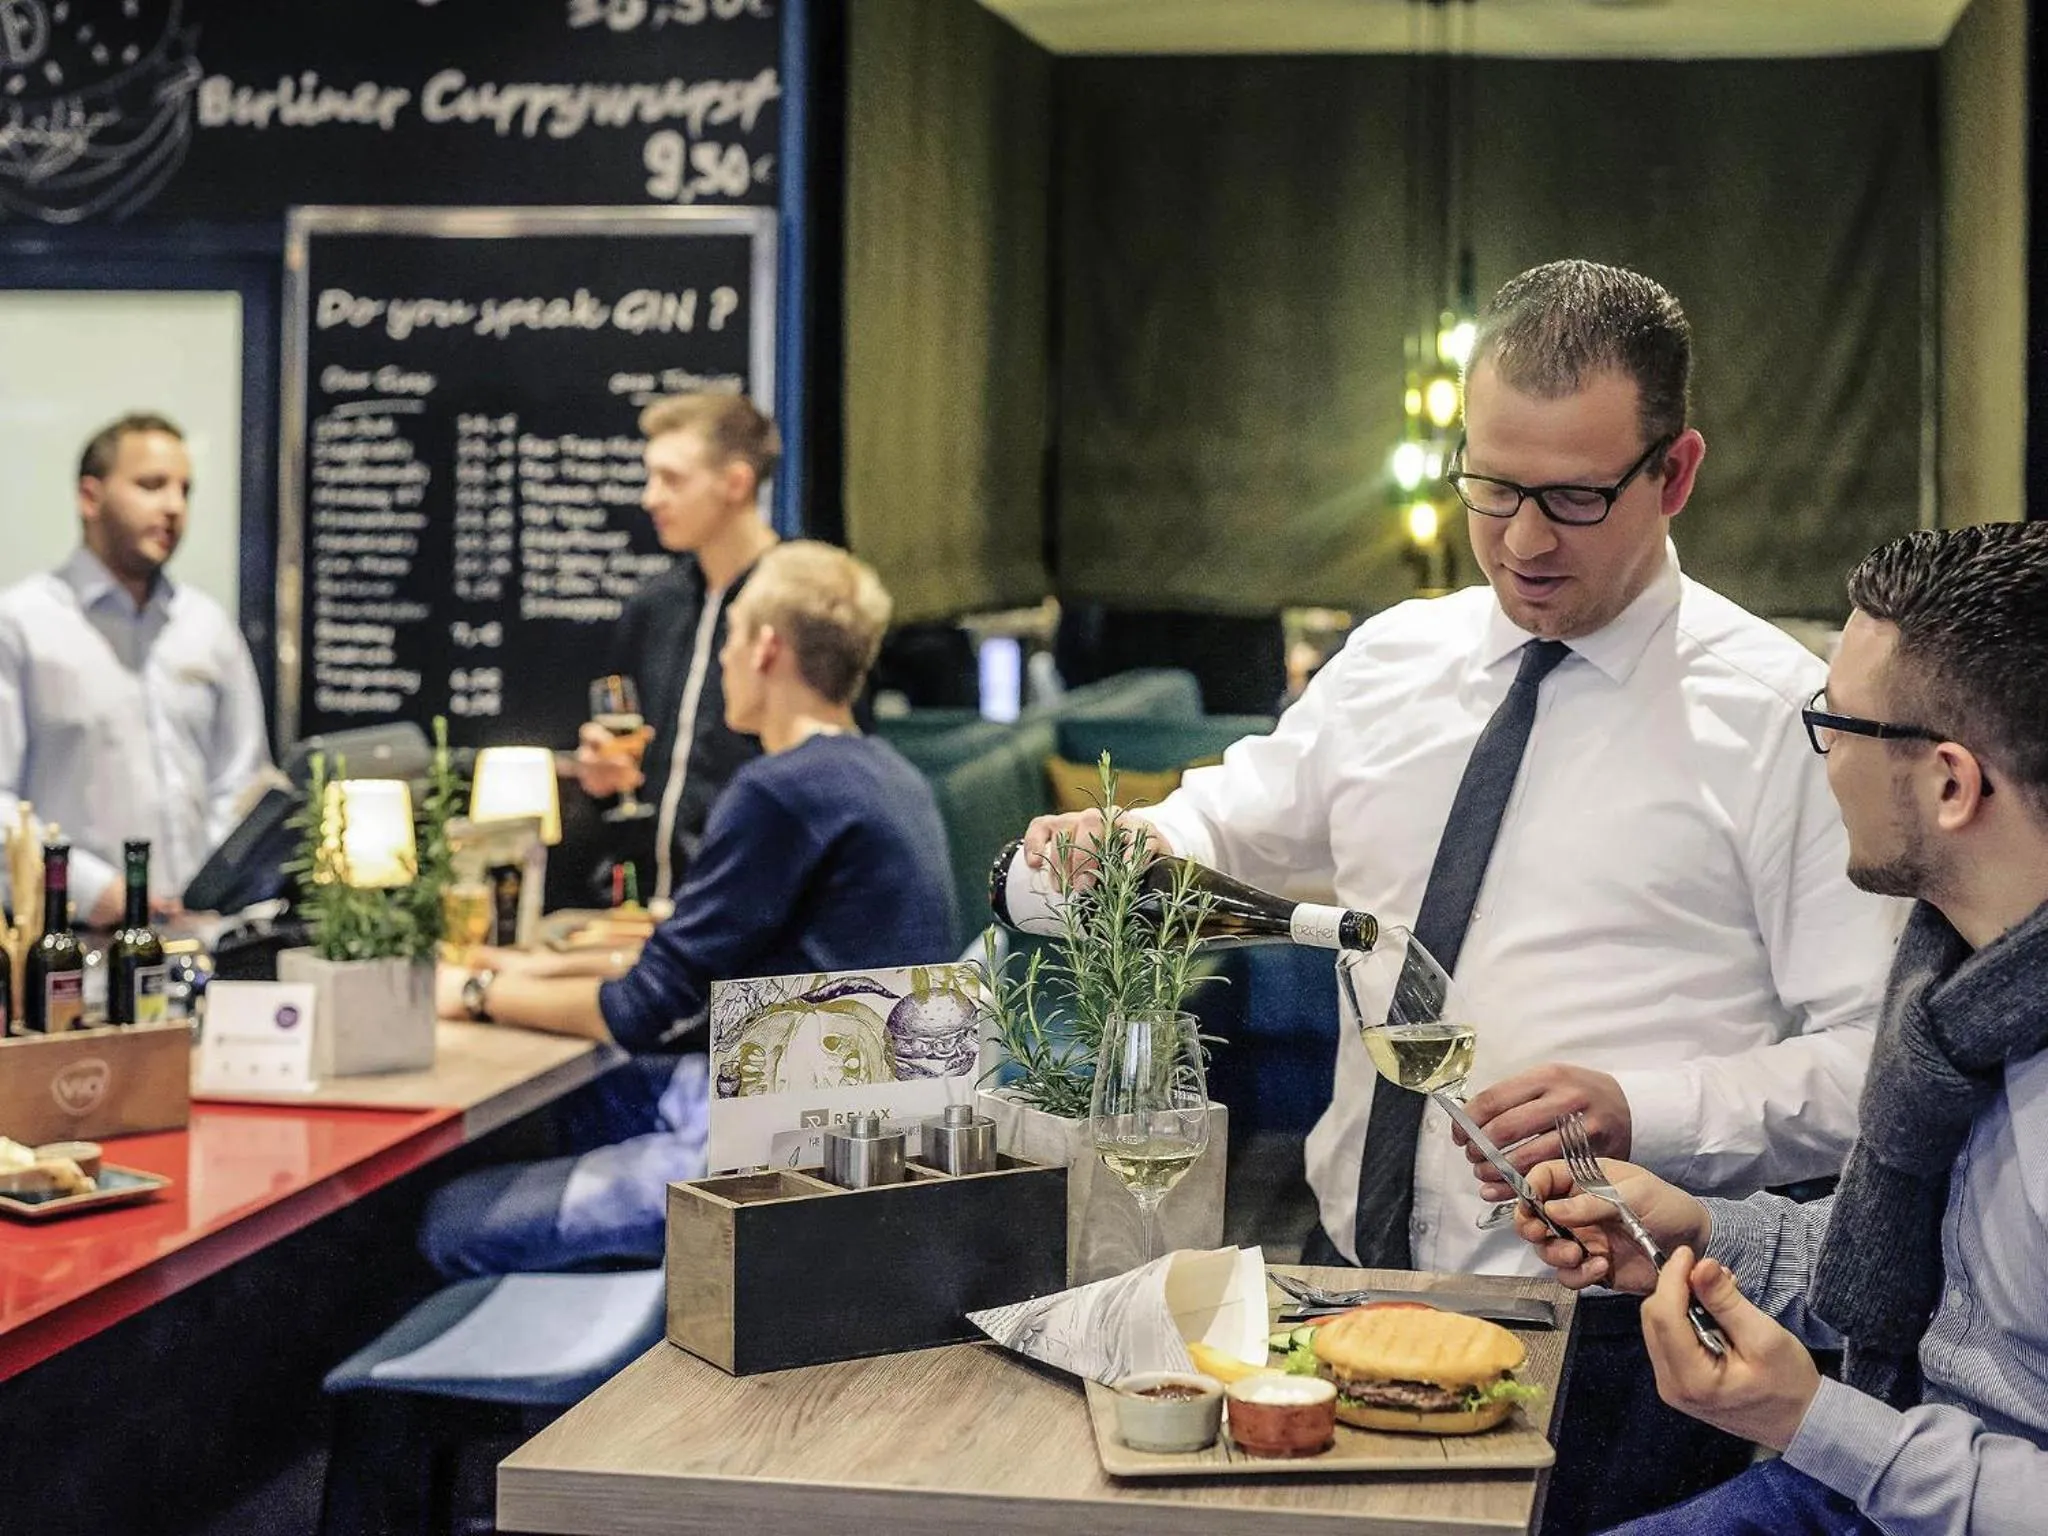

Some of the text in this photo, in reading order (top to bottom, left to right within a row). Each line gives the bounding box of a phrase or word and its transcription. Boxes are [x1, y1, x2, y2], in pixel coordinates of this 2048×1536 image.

[198, 68, 780, 138] Berliner Currywurst
[316, 288, 386, 330] Do
[386, 298, 477, 340] you
[474, 287, 611, 340] speak
[613, 289, 698, 335] GIN
